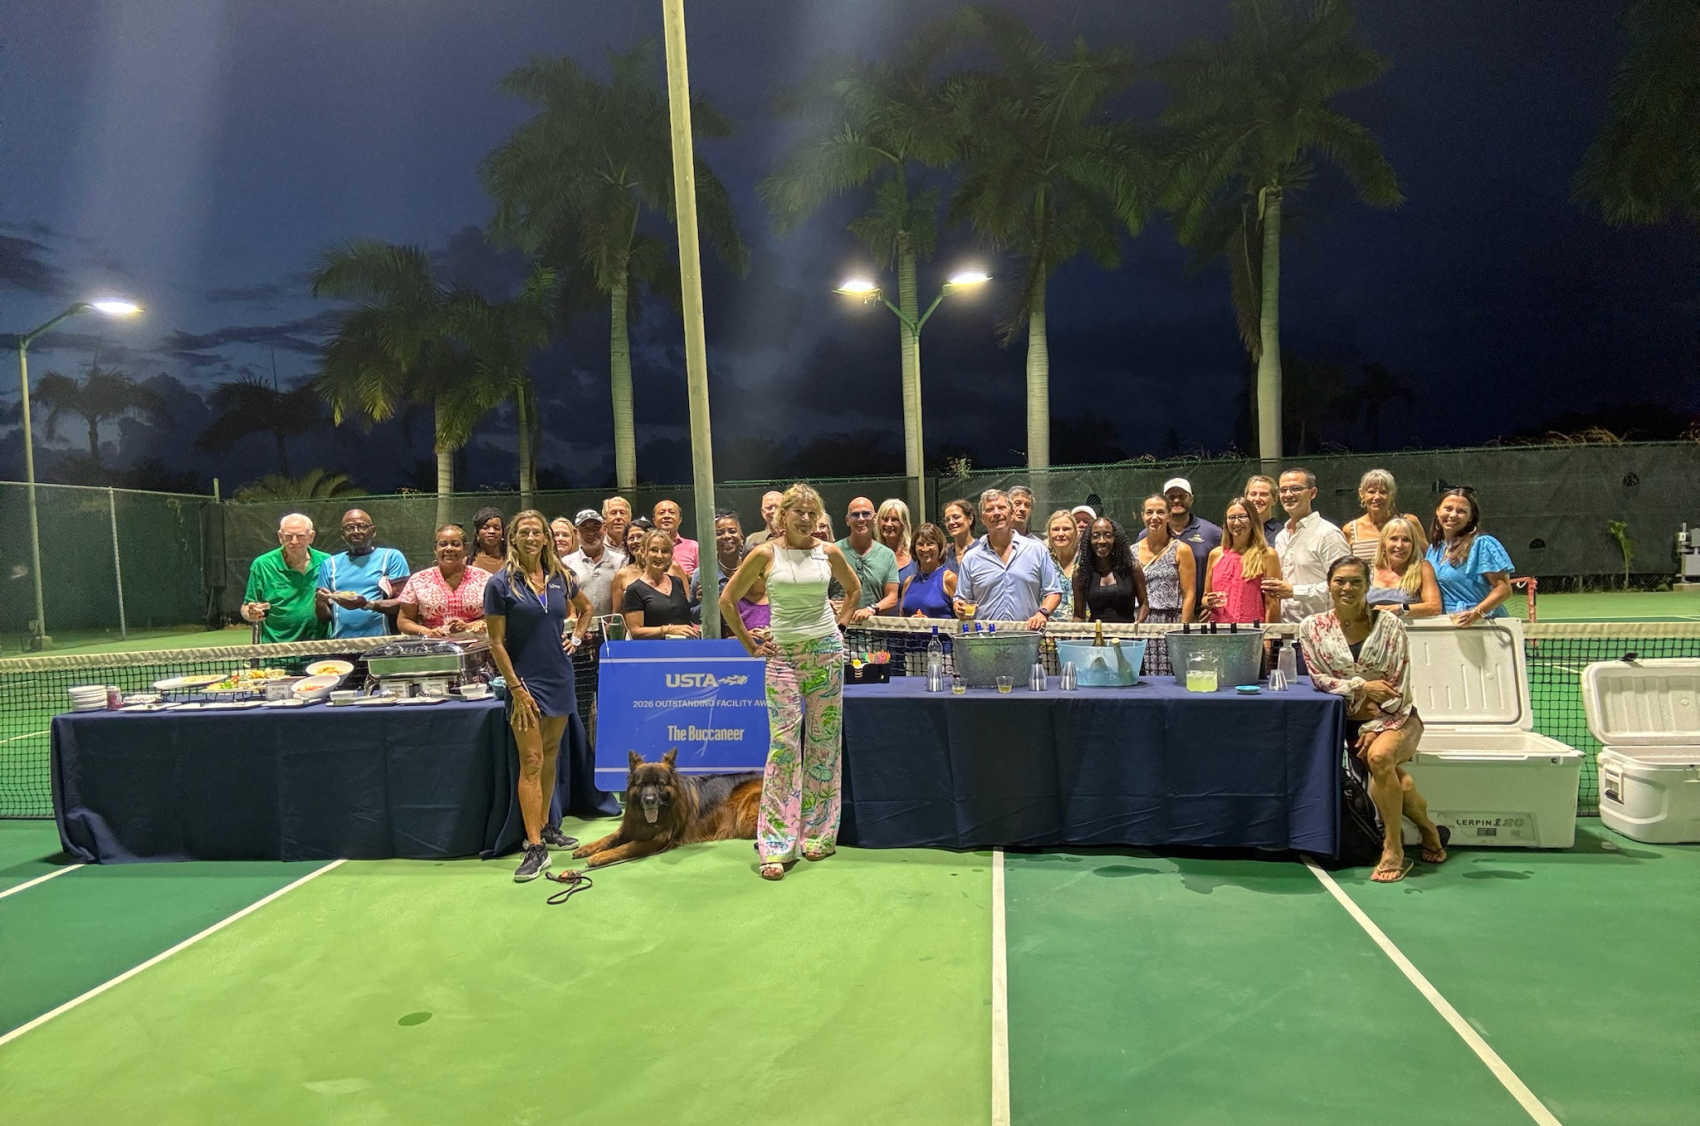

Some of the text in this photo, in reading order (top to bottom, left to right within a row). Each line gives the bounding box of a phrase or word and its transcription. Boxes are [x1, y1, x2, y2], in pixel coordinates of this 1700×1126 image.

[665, 673, 719, 688] USTA
[655, 699, 715, 708] OUTSTANDING
[716, 699, 753, 708] FACILITY
[667, 725, 744, 741] The Buccaneer
